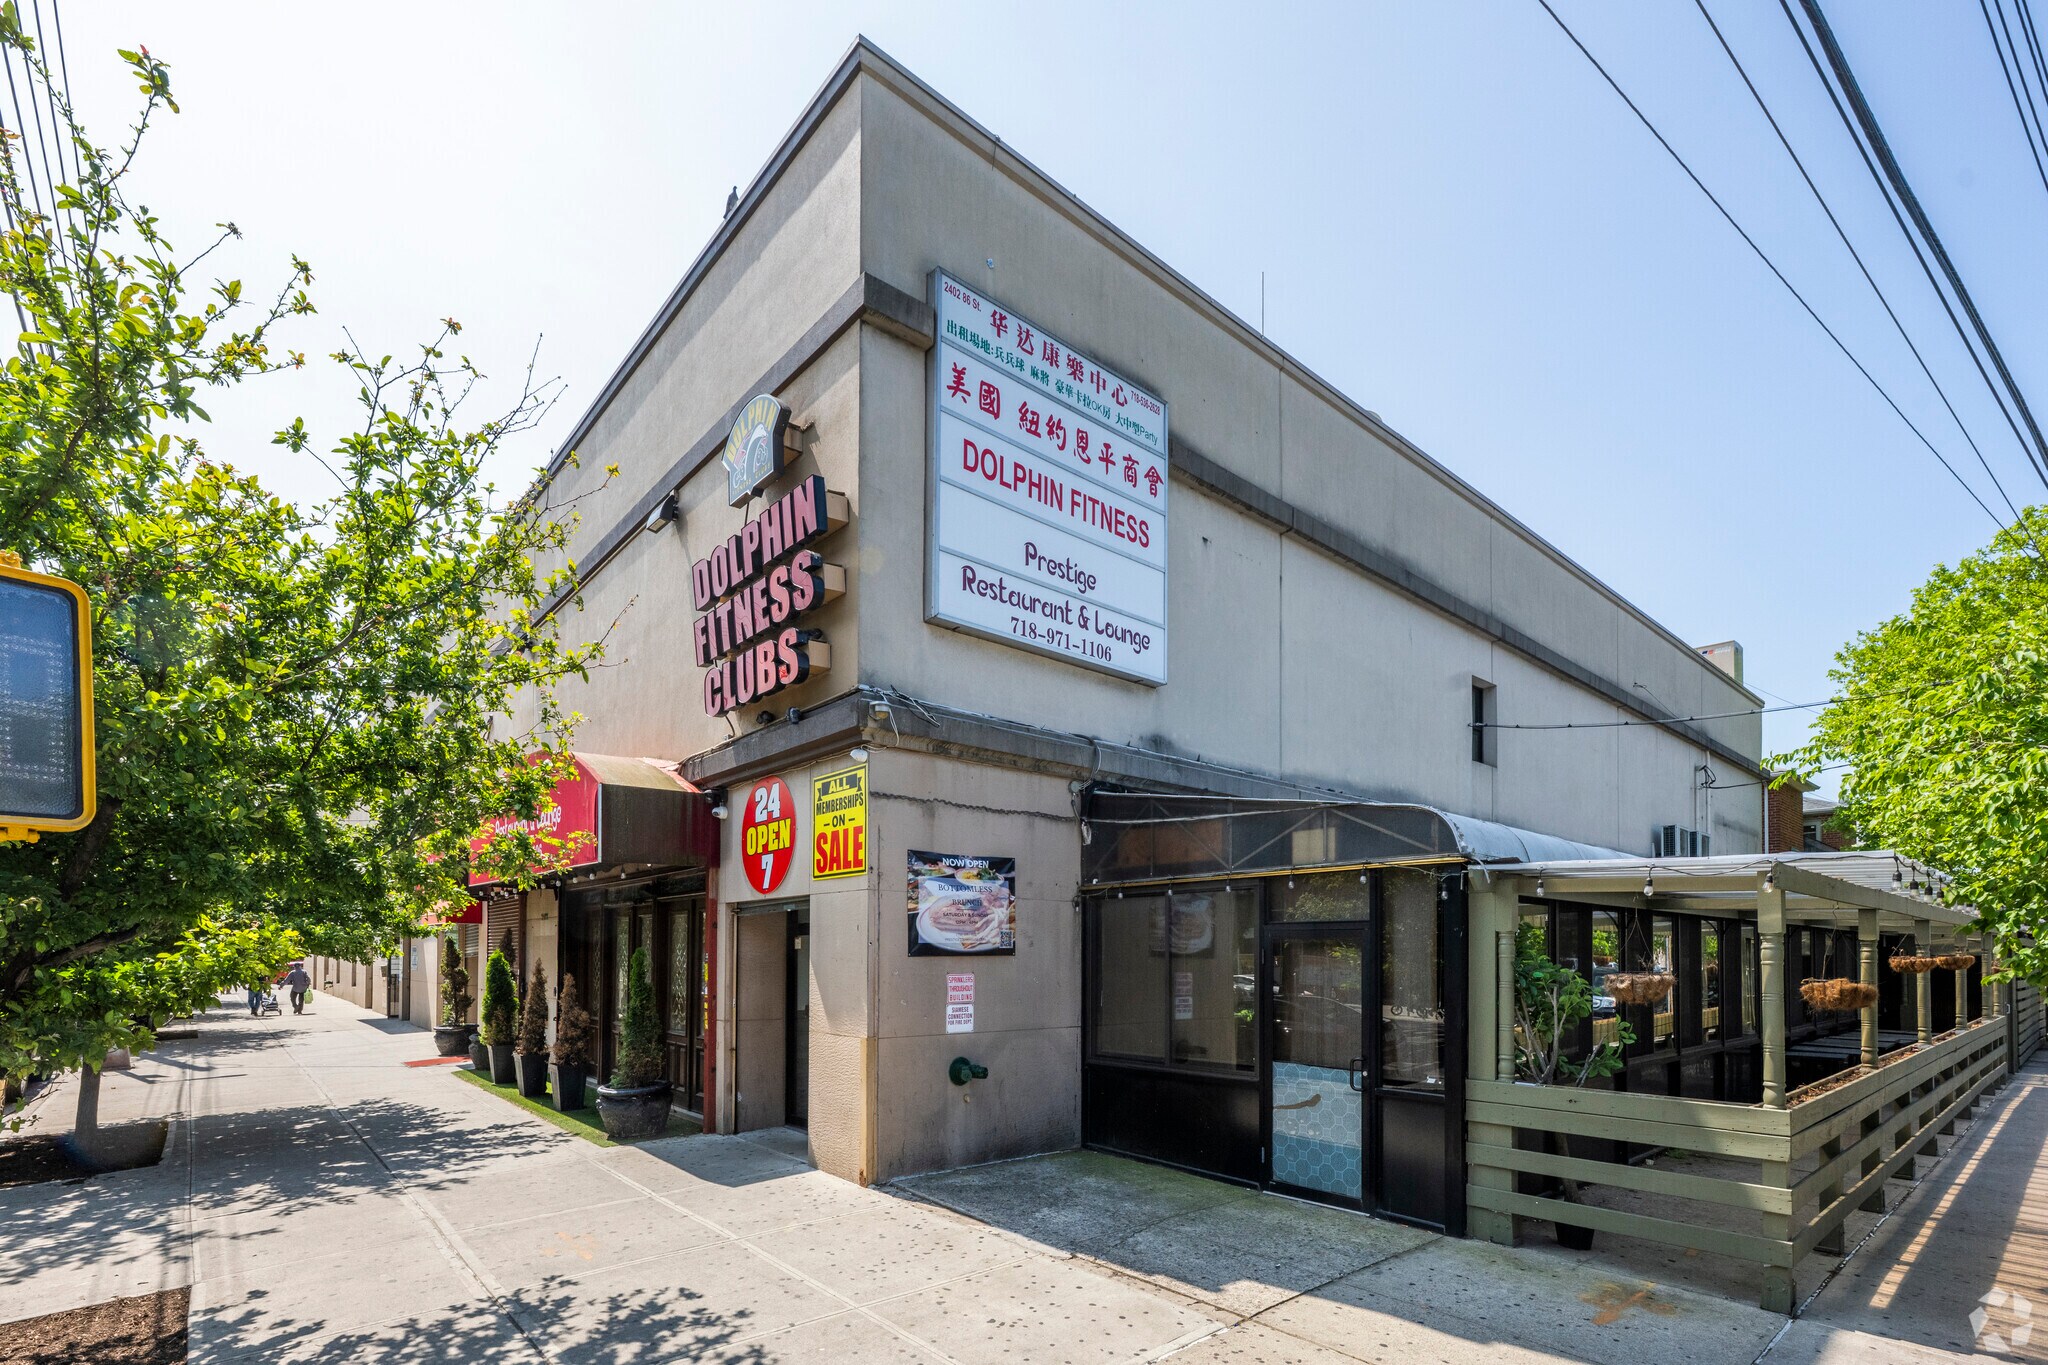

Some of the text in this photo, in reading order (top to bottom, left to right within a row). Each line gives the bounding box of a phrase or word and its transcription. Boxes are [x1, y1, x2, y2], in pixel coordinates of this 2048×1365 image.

[944, 281, 982, 312] 2402 86 St.
[990, 309, 1128, 407] 华达康樂中心
[725, 399, 777, 464] DOLPHIN
[946, 361, 1164, 499] 美國 紐約恩平商會
[962, 438, 1150, 549] DOLPHIN FITNESS
[691, 474, 822, 611] DOLPHIN
[1024, 541, 1097, 594] Prestige
[693, 549, 818, 667] FITNESS
[961, 565, 1150, 655] Restaurant & Lounge
[1010, 616, 1112, 662] 718-971-1106
[704, 627, 802, 718] CLUBS
[755, 782, 781, 823] 24
[816, 792, 864, 816] MEMBERSHIPS
[828, 776, 850, 794] ALL
[746, 818, 791, 856] OPEN
[832, 814, 846, 828] ON
[815, 825, 864, 874] SALE
[942, 857, 989, 869] NOW OPEN
[761, 853, 774, 890] 7
[938, 883, 993, 893] BOTTOMLESS
[952, 898, 983, 907] BRUNCH
[948, 976, 973, 984] SPRINKLERS
